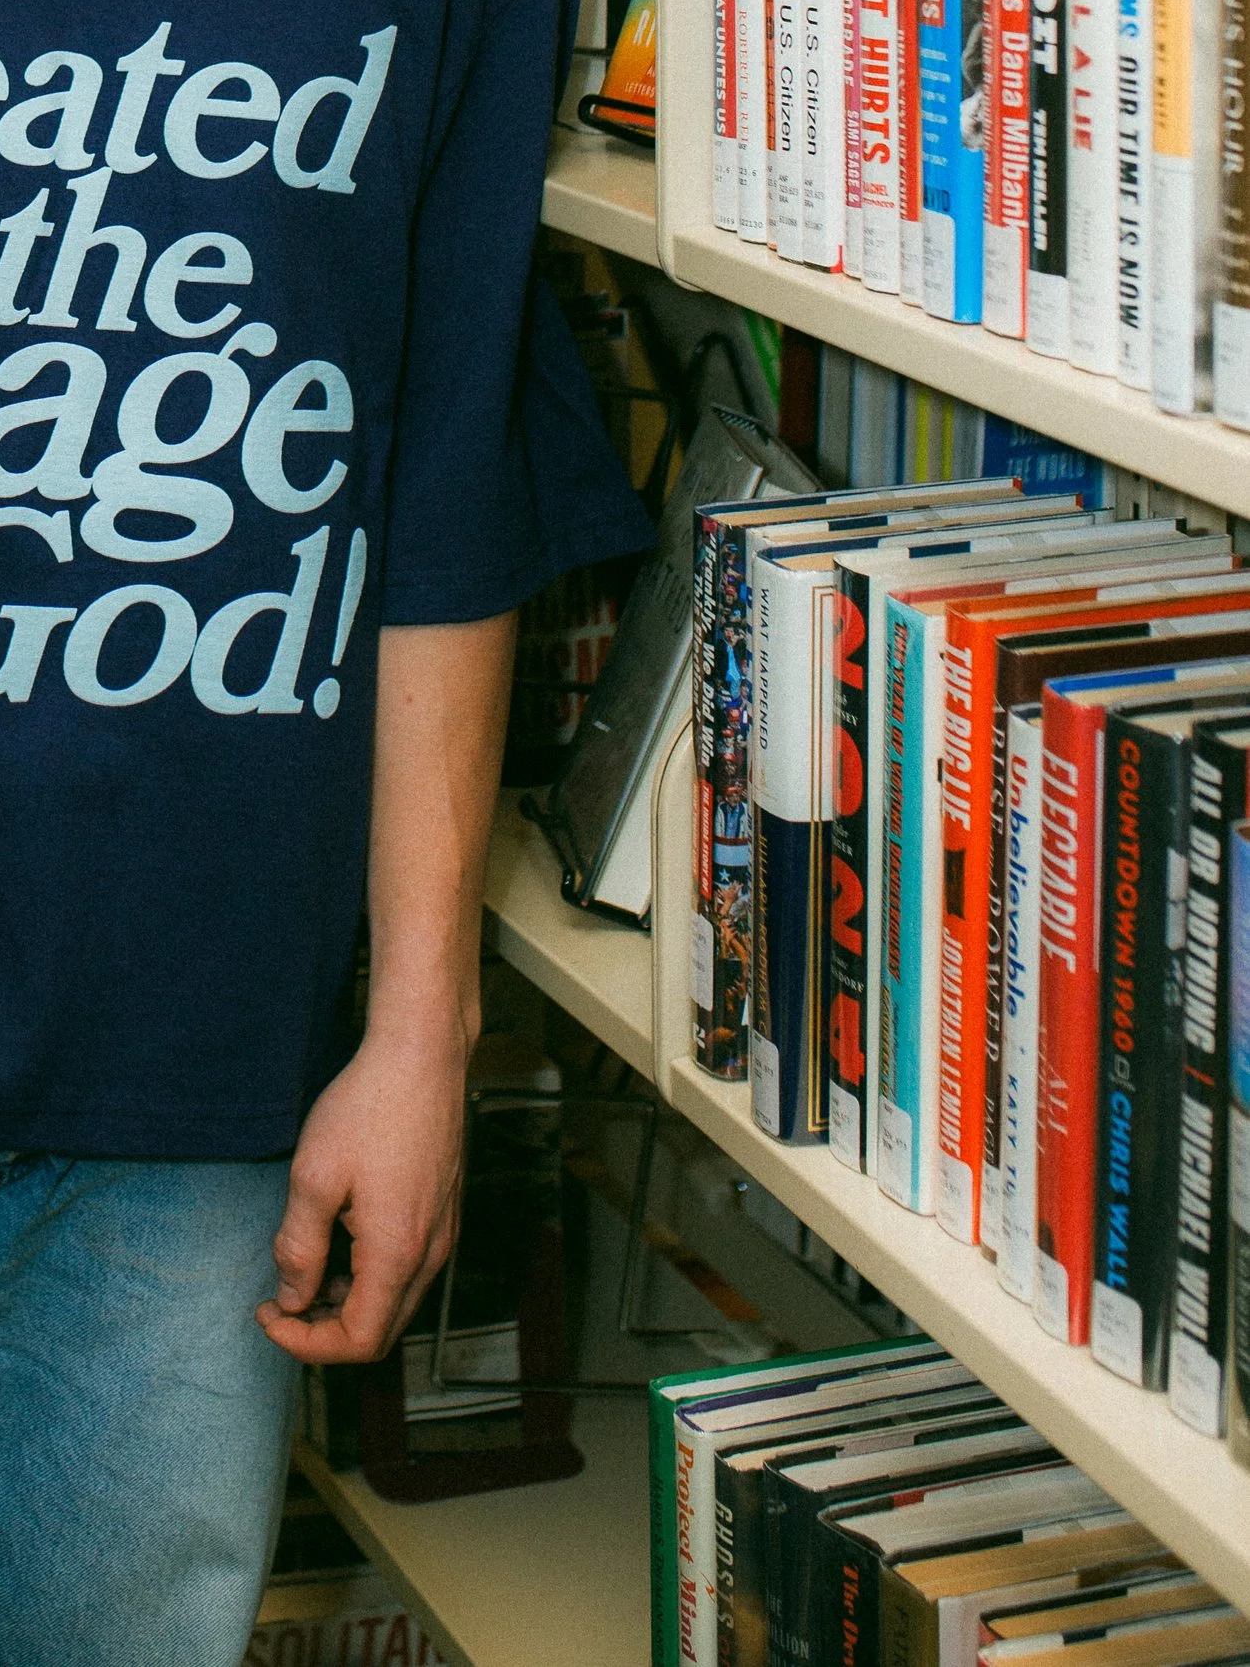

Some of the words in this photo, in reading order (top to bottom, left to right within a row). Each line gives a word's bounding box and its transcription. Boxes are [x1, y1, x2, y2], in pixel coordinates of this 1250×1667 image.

[716, 26, 727, 105] UNITES
[738, 10, 749, 82] ROBERT
[780, 5, 792, 54] U.S.
[806, 7, 818, 57] U.S.
[1032, 16, 1058, 74] IT
[1072, 45, 1092, 72] A
[860, 36, 891, 164] HURTS
[1001, 30, 1029, 107] Dana
[1119, 54, 1141, 116] OUR
[715, 107, 727, 134] US
[780, 66, 793, 152] Citizen
[806, 69, 820, 155] Citizen
[846, 110, 859, 145] SAMI
[1033, 109, 1048, 158] TIM
[1072, 86, 1092, 151] LIE
[1222, 57, 1245, 174] HOUR
[846, 151, 859, 187] SAGE
[1119, 129, 1140, 205] TIME
[1032, 160, 1048, 251] MILLER
[1119, 215, 1140, 247] IS
[1119, 256, 1140, 329] NOW
[759, 588, 770, 641] WHAT
[894, 622, 908, 664] THE
[701, 642, 715, 674] We
[943, 644, 973, 712] THE
[701, 681, 715, 722] Did
[759, 649, 770, 750] HAPPENED
[892, 666, 907, 723] YEAR
[701, 726, 715, 769] Win
[891, 725, 905, 755] OF
[942, 710, 973, 772] BIG
[701, 785, 711, 805] THE
[890, 760, 905, 839] VOTING
[941, 772, 972, 831] LIE
[1191, 755, 1222, 820] ALL
[701, 808, 710, 840] INSIDE
[1115, 739, 1141, 968] COUNTDOWN
[1189, 825, 1221, 885] OR
[701, 844, 710, 879] STORY
[758, 834, 769, 913] HILLARY
[1007, 754, 1029, 1019] Unbelievable
[1041, 747, 1079, 974] ELECTABLE
[888, 842, 903, 984] DANGEROUSLY
[758, 924, 770, 1011] RODHAM
[941, 927, 963, 1061] JONATHAN
[986, 894, 1002, 1063] POWER
[1183, 888, 1219, 1055] NOTHING
[1113, 977, 1136, 1052] 1960
[940, 1061, 962, 1159] LEMIRE
[1006, 1074, 1019, 1148] KATY
[1109, 1091, 1133, 1194] CHRIS
[1179, 1094, 1214, 1254] MICHAEL
[678, 1441, 695, 1565] Project
[716, 1499, 734, 1629] GHOSTS
[843, 1564, 861, 1615] The
[679, 1573, 698, 1663] Mind
